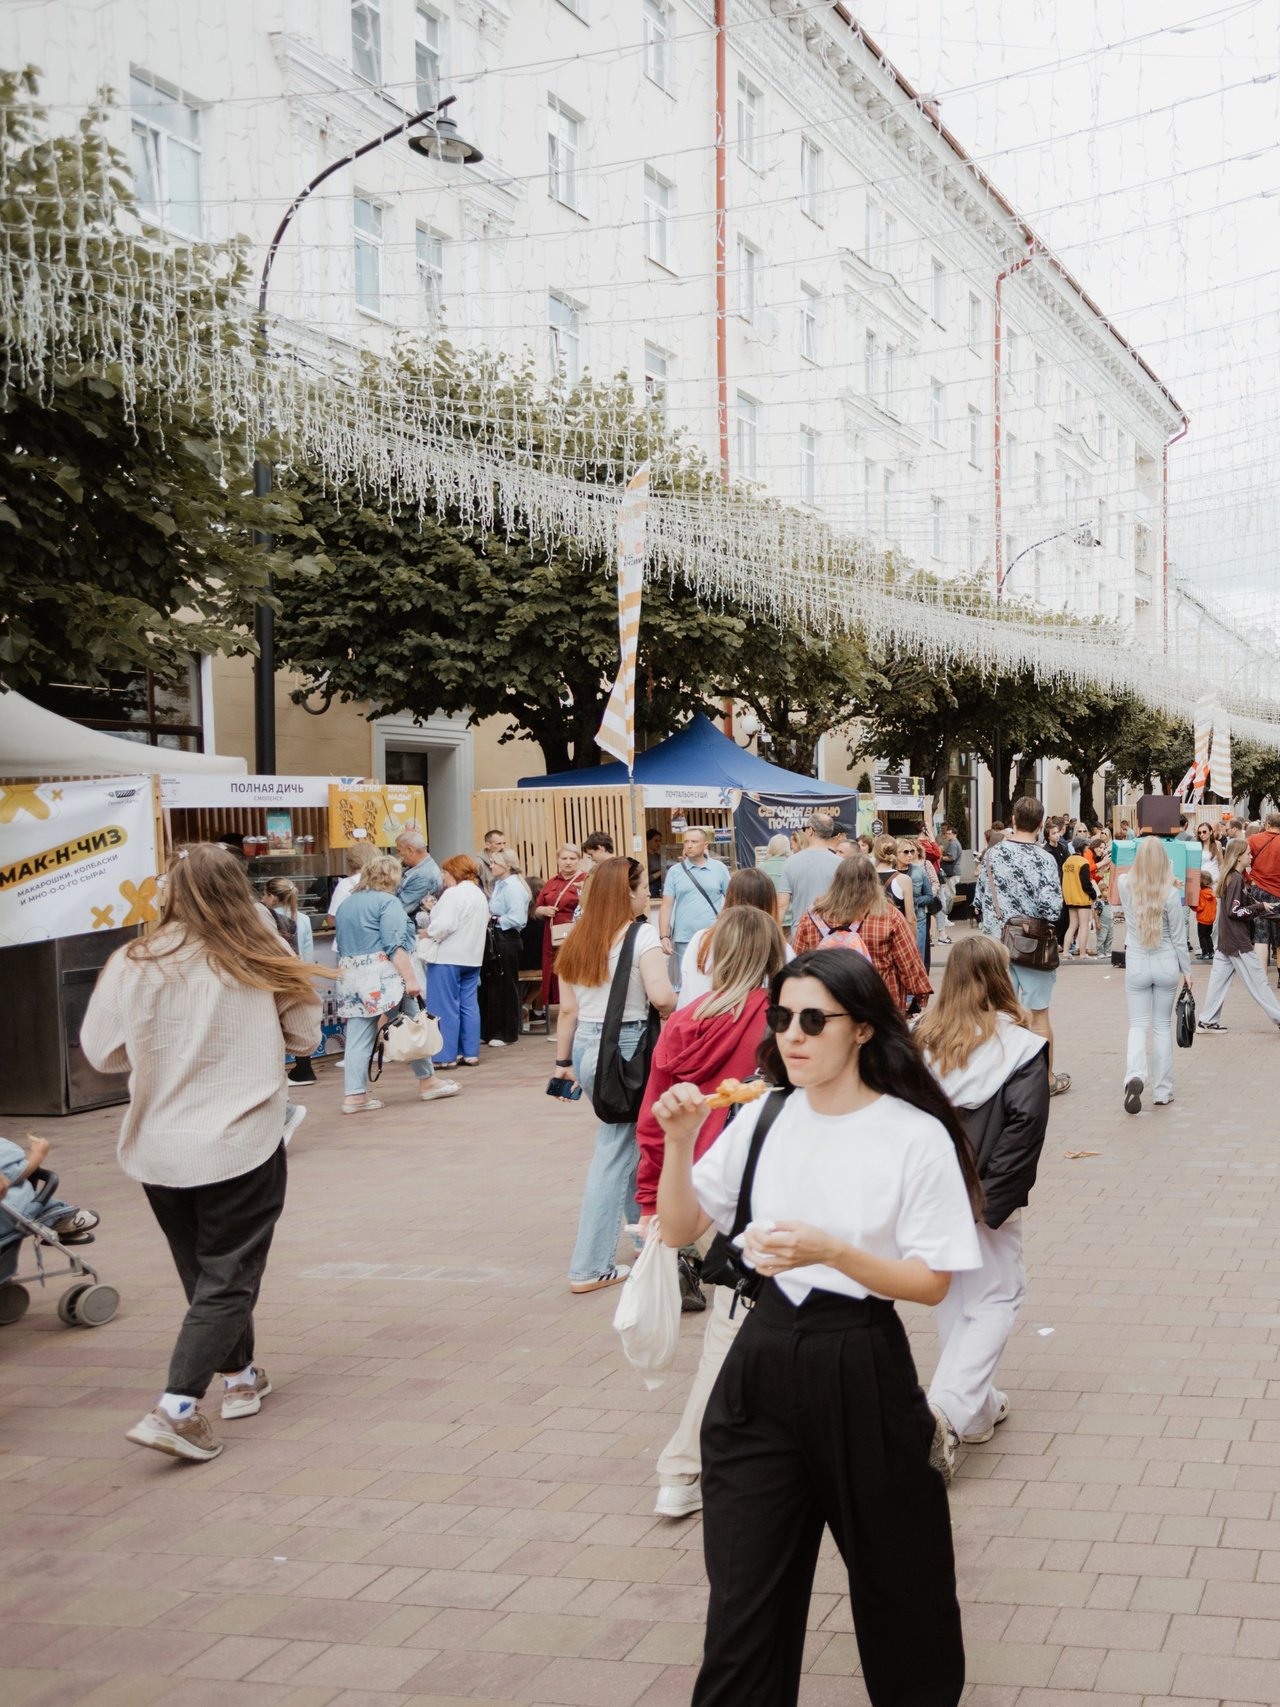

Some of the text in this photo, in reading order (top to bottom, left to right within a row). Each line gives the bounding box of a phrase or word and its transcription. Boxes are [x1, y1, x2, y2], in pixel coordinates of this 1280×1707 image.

[231, 783, 304, 794] ПОЛНАЯ ДИЧЬ
[758, 806, 804, 818] СЕГОДНЯ
[804, 807, 814, 817] В
[768, 817, 809, 829] ПОЧТАЛ
[0, 828, 122, 888] МАК-Н-ЧИЗ
[17, 854, 119, 898] МАКАРОШКИ, КОЛБАСКИ
[28, 879, 79, 903] МНО-О-О-ГО
[80, 868, 107, 883] СЫРА!
